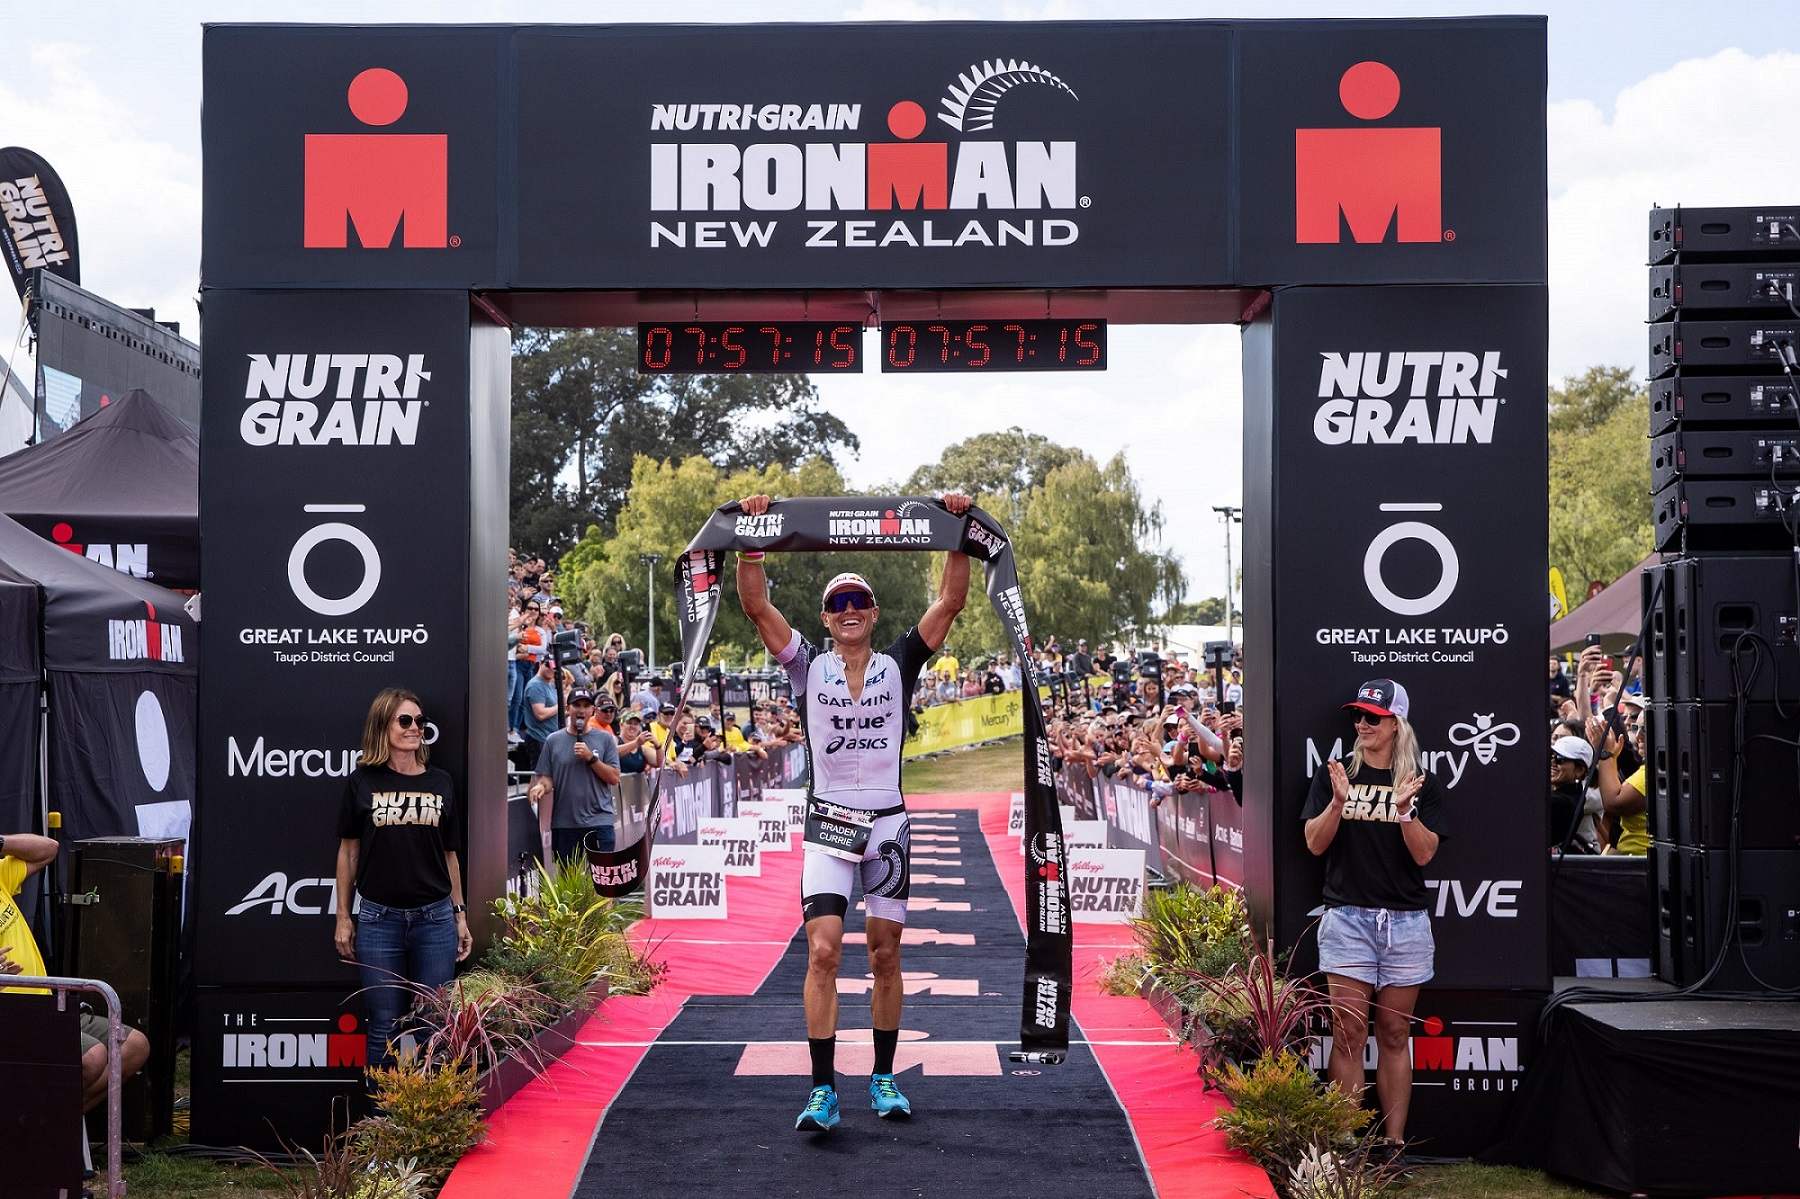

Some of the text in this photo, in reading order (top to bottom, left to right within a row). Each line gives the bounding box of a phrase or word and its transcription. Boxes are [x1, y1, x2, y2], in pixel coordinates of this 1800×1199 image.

[650, 103, 861, 131] NUTRI-GRAIN
[650, 141, 1077, 211] IRONMAN
[0, 182, 48, 269] GRAIN
[650, 218, 1080, 248] NEW ZEALAND
[645, 327, 855, 368] 07:57:15
[888, 324, 1099, 367] 07:57:15
[239, 400, 421, 446] GRAIN
[1313, 398, 1498, 445] GRAIN
[735, 524, 782, 538] GRAIN
[829, 518, 931, 536] IRONMAN
[829, 536, 931, 545] NEW ZEALAND
[968, 527, 999, 558] GRAIN
[681, 560, 695, 623] ZEALAND
[689, 550, 709, 622] ONMAN
[109, 618, 185, 663] IRONMAN
[239, 623, 429, 645] GREAT LAKE TAUPŌ
[997, 591, 1038, 688] NEW ZEALAND
[1316, 623, 1509, 645] GREAT LAKE TAUPŌ
[273, 650, 394, 666] Taupō District Council
[1350, 650, 1474, 665] Taupō District Council
[830, 713, 885, 730] true
[228, 735, 364, 777] Mercur
[372, 806, 442, 828] GRAIN
[1341, 801, 1401, 823] GRAI
[759, 832, 786, 843] AIN
[819, 831, 853, 847] CURRIE
[820, 821, 857, 837] BRADEN
[652, 856, 686, 869] Kellogg's
[724, 853, 755, 867] AIN
[1071, 861, 1105, 873] Kellogg's
[592, 868, 638, 887] GRAIN
[1046, 832, 1060, 934] IRONMAN
[653, 889, 721, 907] GRAIN
[1070, 894, 1137, 912] GRAIN
[1045, 979, 1058, 1030] GRAIN
[223, 1013, 258, 1027] THE
[1307, 1015, 1328, 1028] TH
[223, 1033, 367, 1068] IRONM
[1308, 1036, 1519, 1071] IMAN
[1453, 1078, 1519, 1092] GROUP
